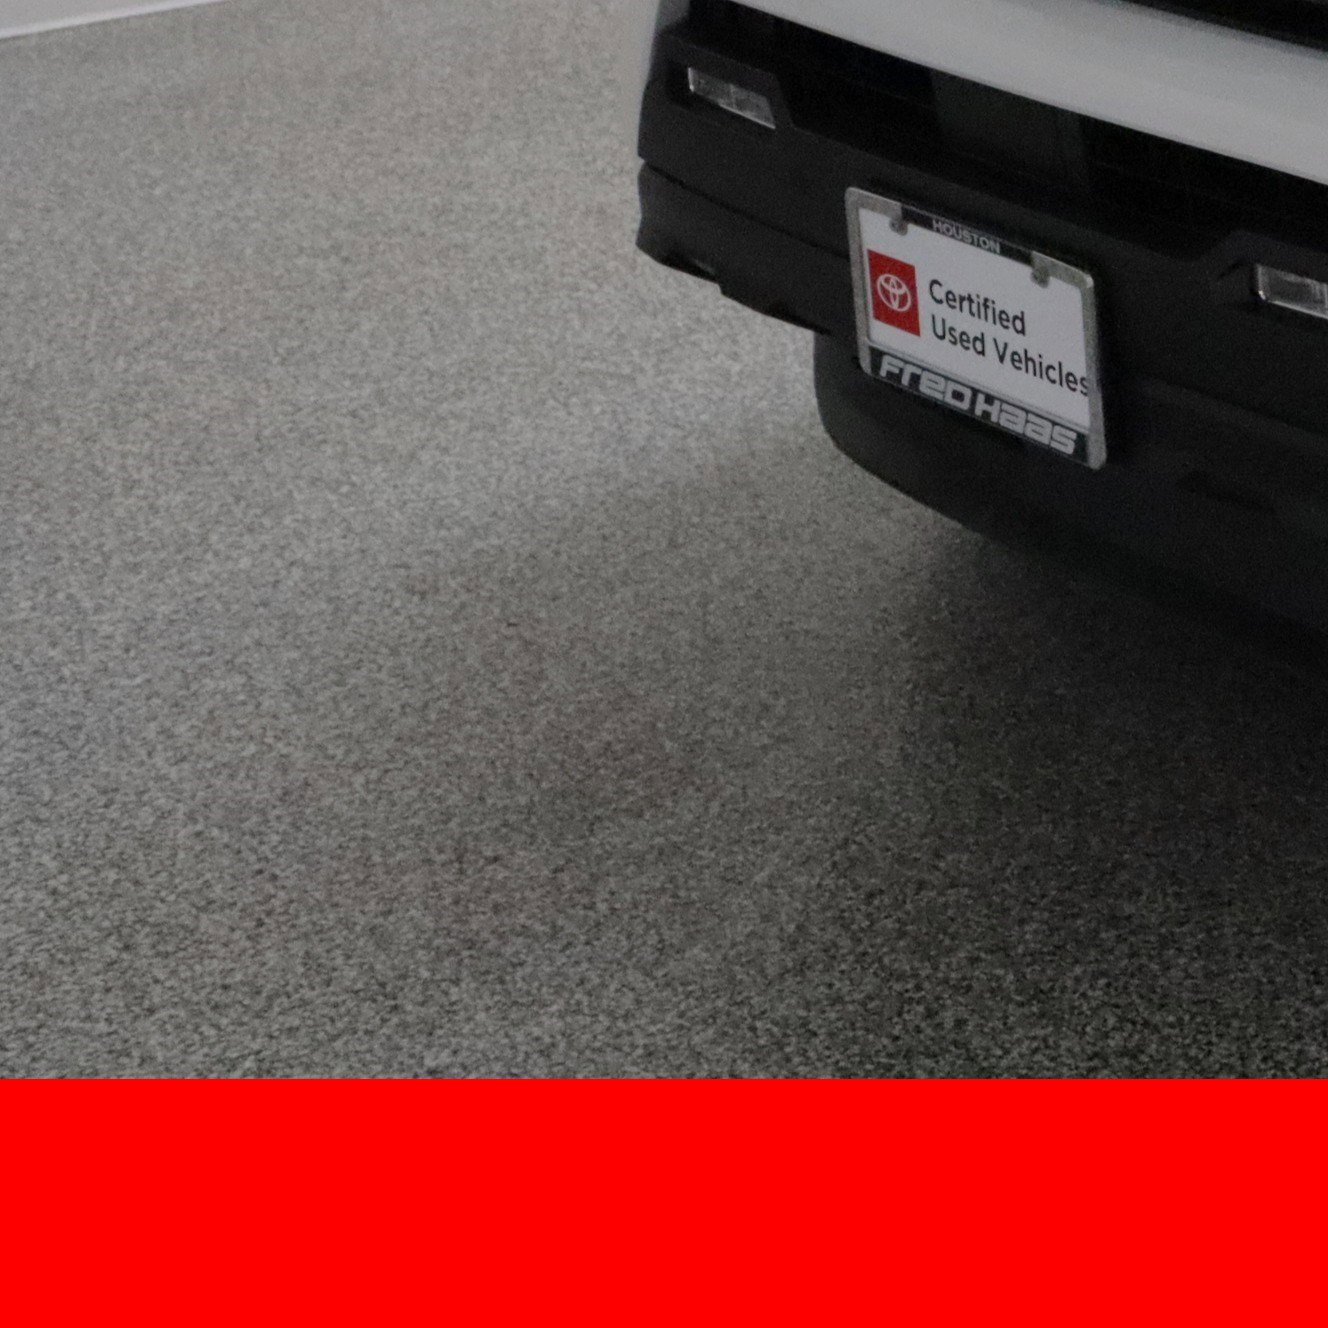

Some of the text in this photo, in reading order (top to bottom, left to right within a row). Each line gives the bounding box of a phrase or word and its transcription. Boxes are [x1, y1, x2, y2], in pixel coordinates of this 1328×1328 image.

[932, 218, 1001, 254] HOUSTON
[929, 278, 1026, 337] Certified
[931, 314, 1088, 397] Used Vehicles
